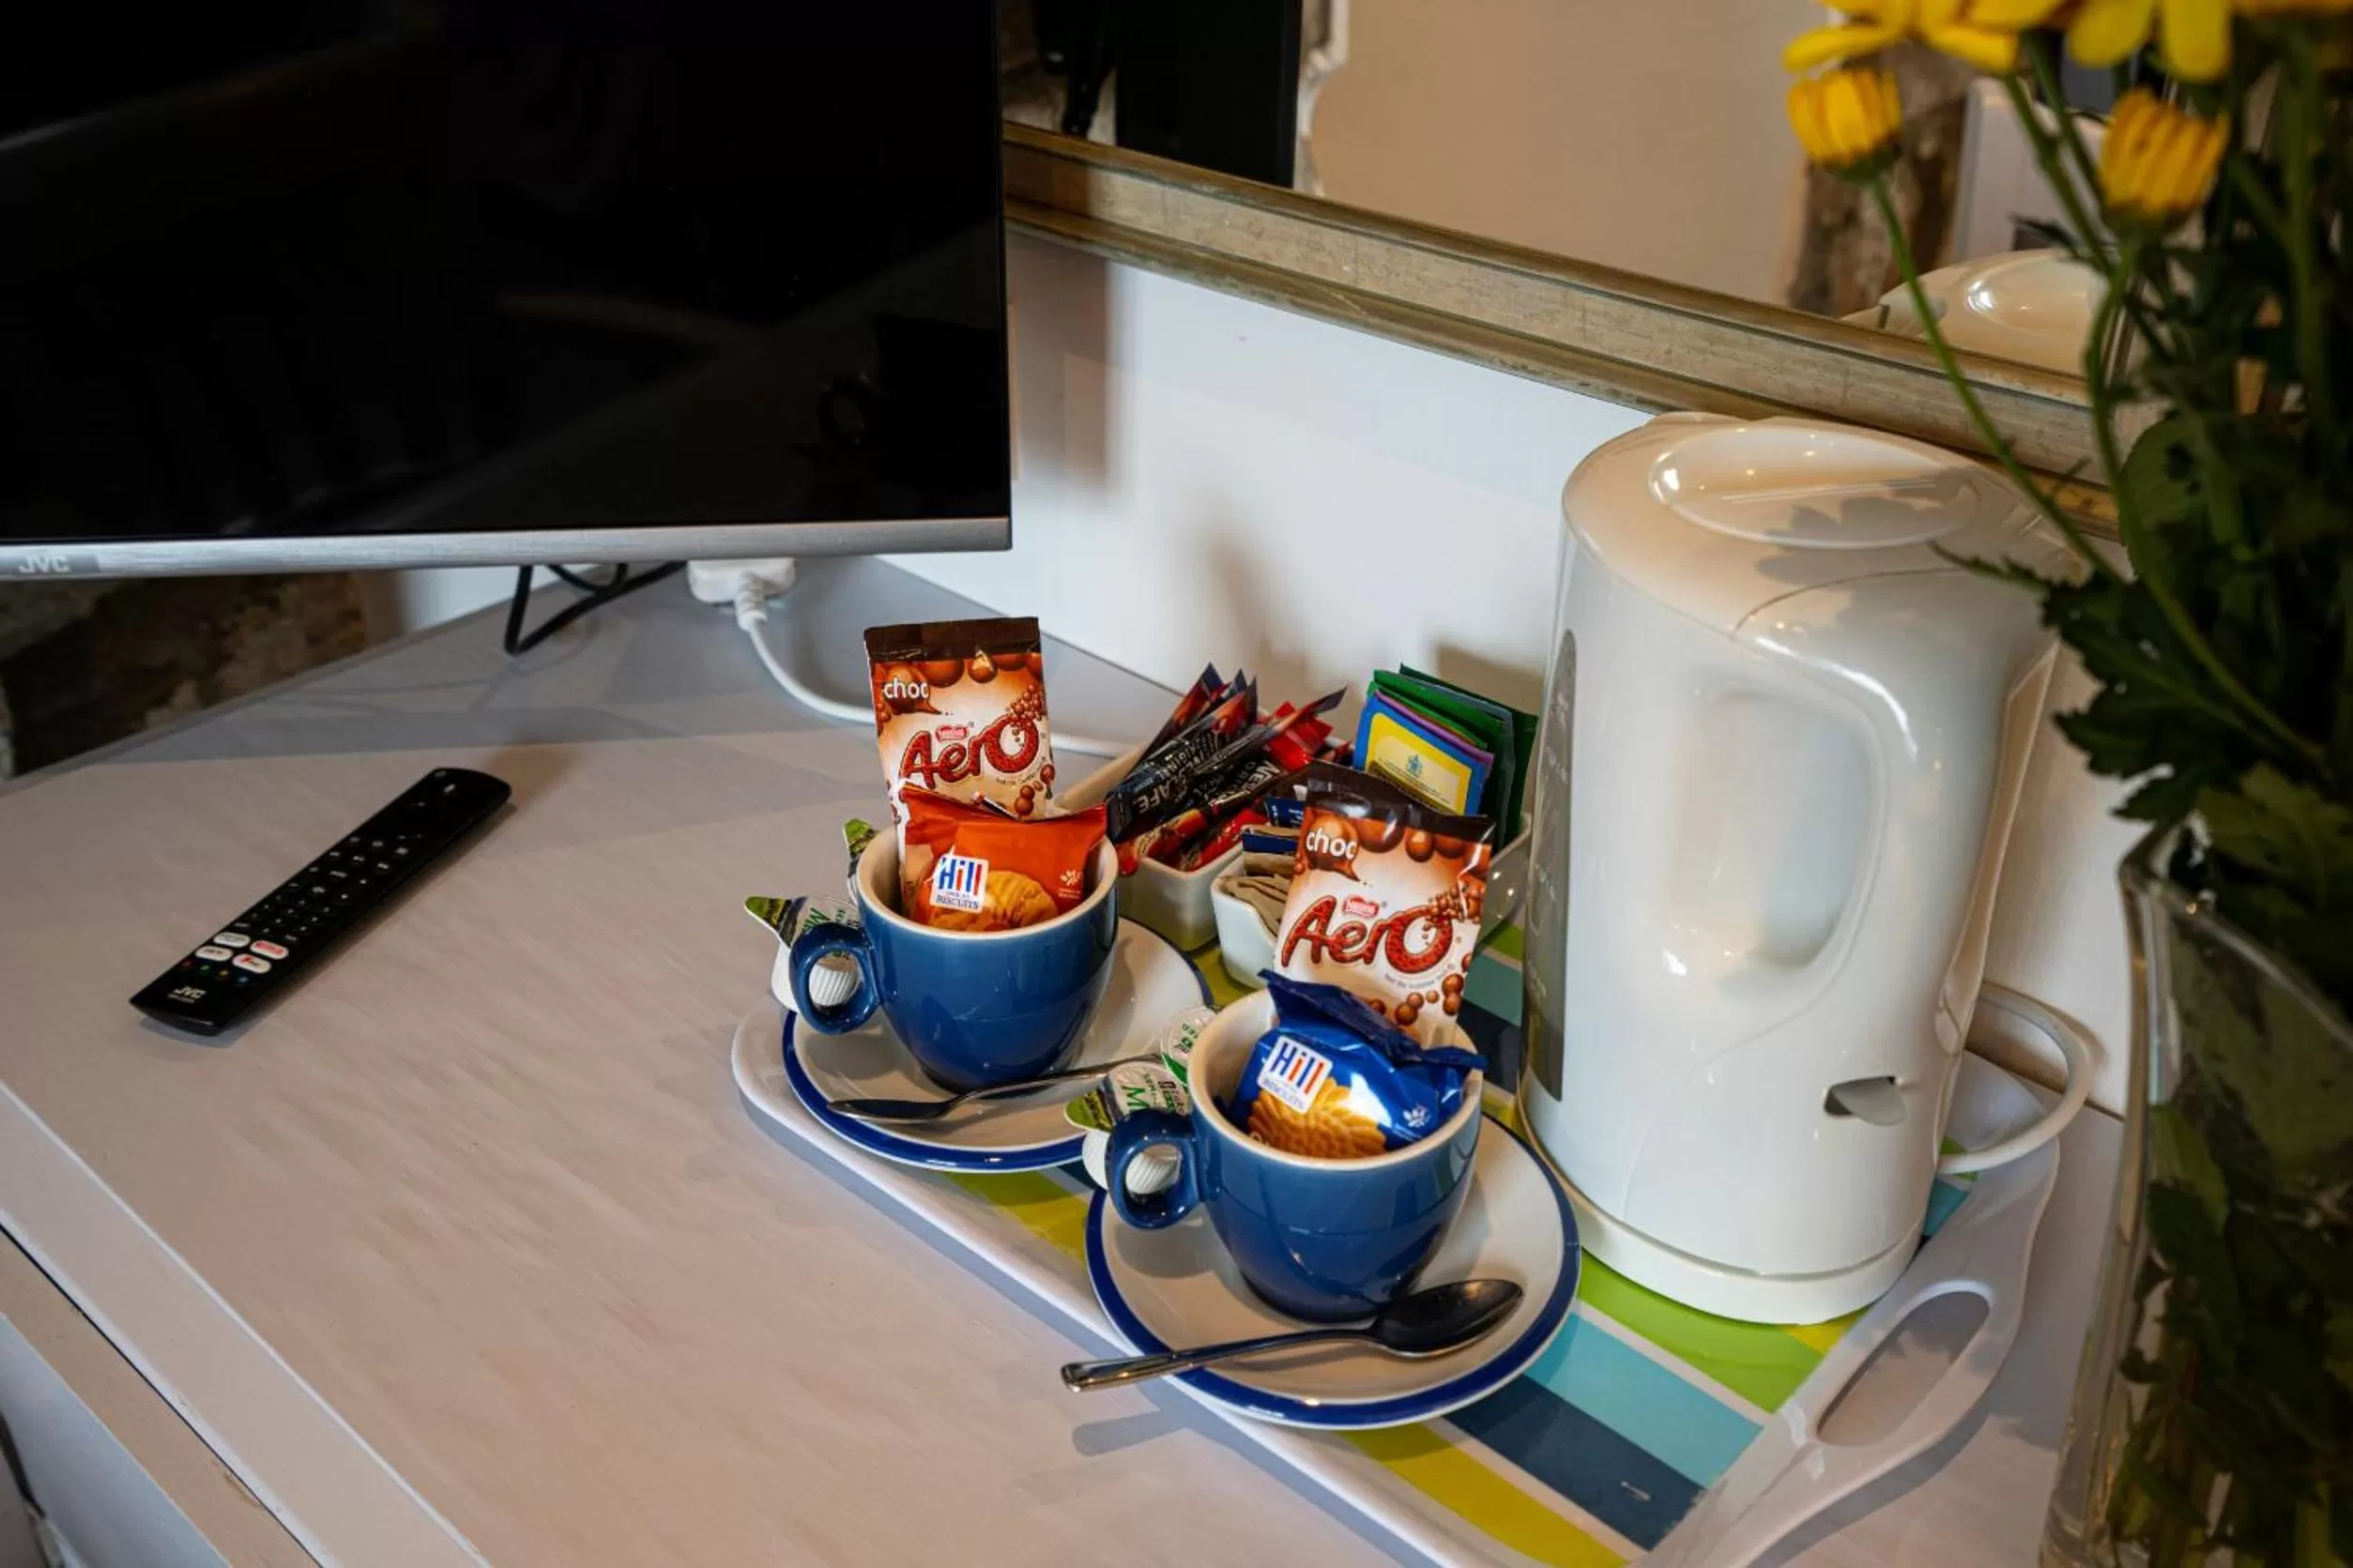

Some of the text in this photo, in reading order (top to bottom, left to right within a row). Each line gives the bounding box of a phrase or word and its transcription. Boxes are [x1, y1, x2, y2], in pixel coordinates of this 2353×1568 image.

[19, 555, 71, 573] JVC
[883, 677, 928, 698] choc
[1306, 827, 1357, 860] choc
[939, 857, 983, 896] Hill
[1269, 1042, 1324, 1095] Hill
